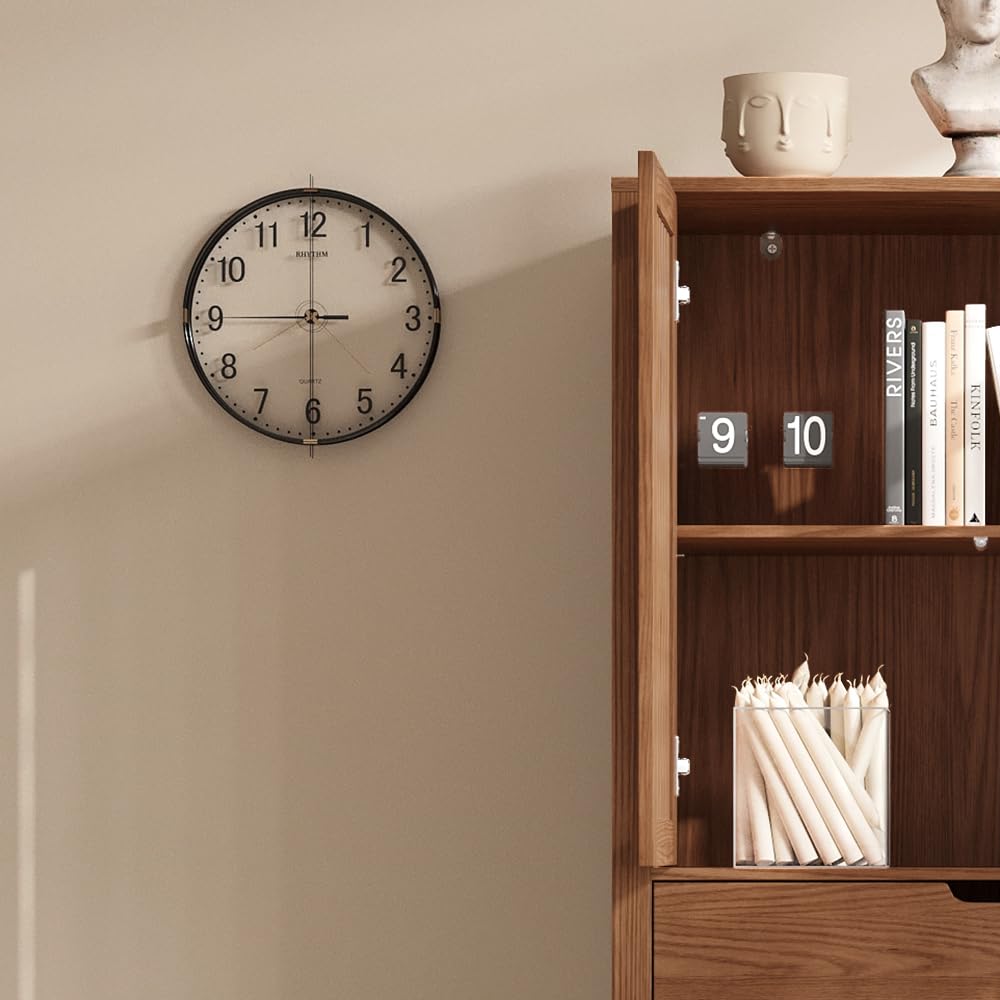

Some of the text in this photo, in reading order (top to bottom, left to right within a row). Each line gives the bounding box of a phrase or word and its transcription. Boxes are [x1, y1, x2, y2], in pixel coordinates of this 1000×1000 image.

[255, 222, 278, 248] 11
[300, 212, 327, 238] 12
[361, 222, 370, 248] 1
[218, 256, 246, 282] 10
[391, 256, 407, 282] 2
[208, 306, 224, 331] 9
[405, 306, 421, 331] 3
[221, 353, 237, 379] 8
[390, 353, 407, 379] 4
[886, 317, 902, 397] RIVERS
[254, 388, 268, 414] 7
[306, 398, 321, 424] 6
[357, 388, 373, 414] 5
[971, 384, 983, 451] KINFOLK
[712, 418, 735, 454] 9
[787, 416, 826, 456] 10
